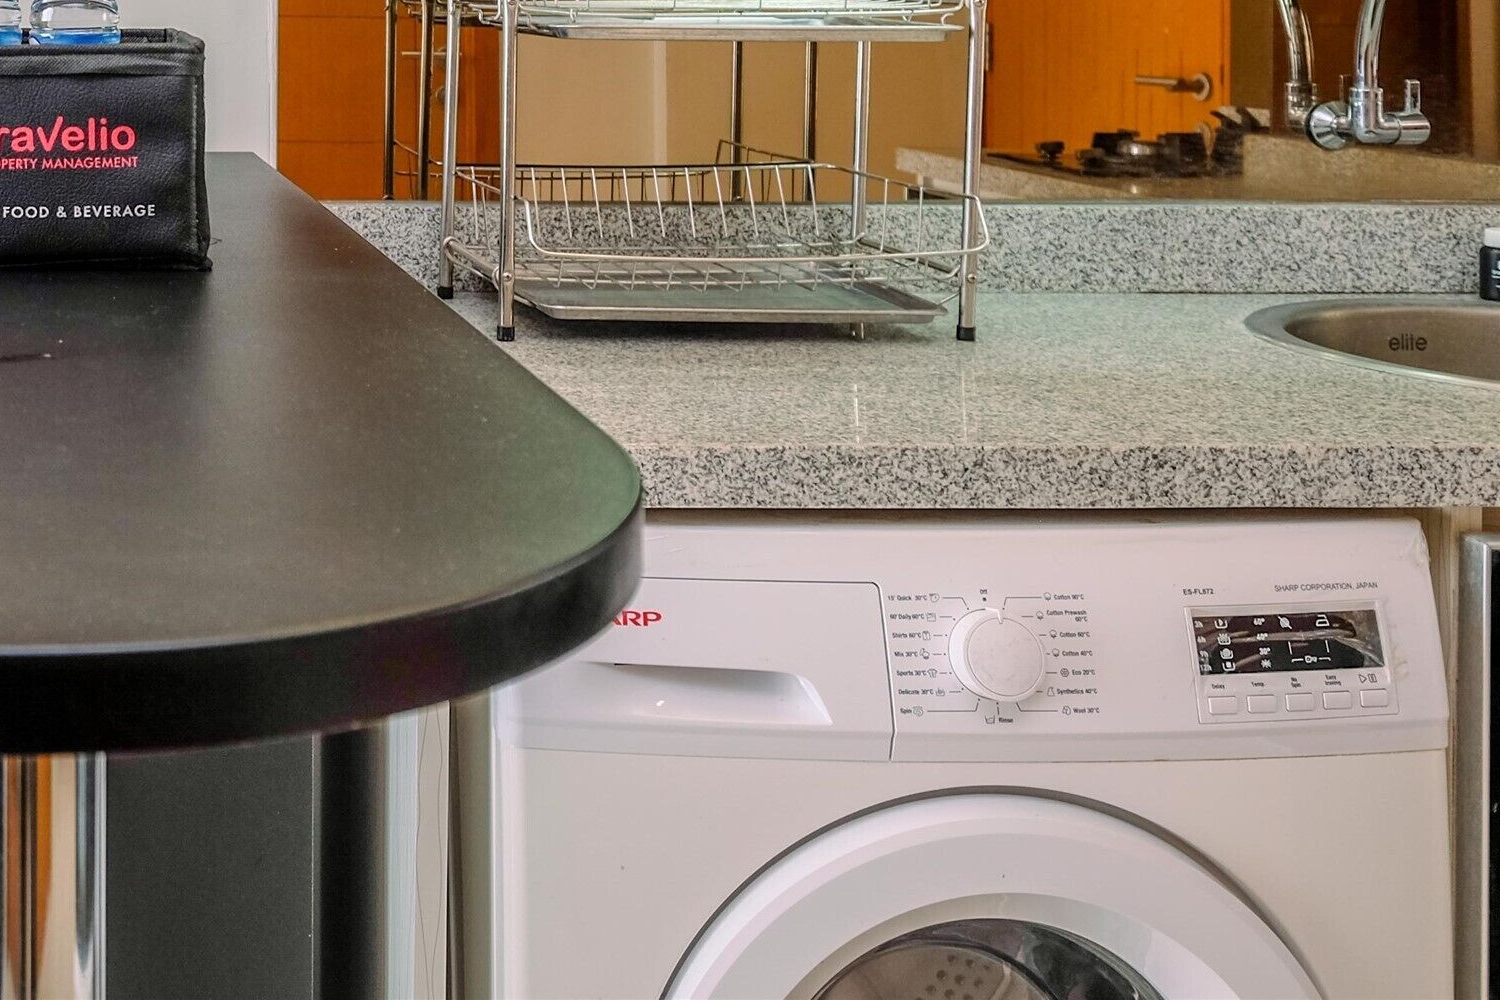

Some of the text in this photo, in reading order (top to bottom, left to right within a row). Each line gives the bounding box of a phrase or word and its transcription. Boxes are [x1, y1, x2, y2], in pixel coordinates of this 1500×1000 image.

[42, 156, 138, 169] MANAGEMENT
[3, 206, 50, 219] FOOD
[56, 206, 67, 218] &
[73, 204, 156, 218] BEVERAGE
[1388, 333, 1428, 351] elite
[1274, 584, 1299, 592] SHARP
